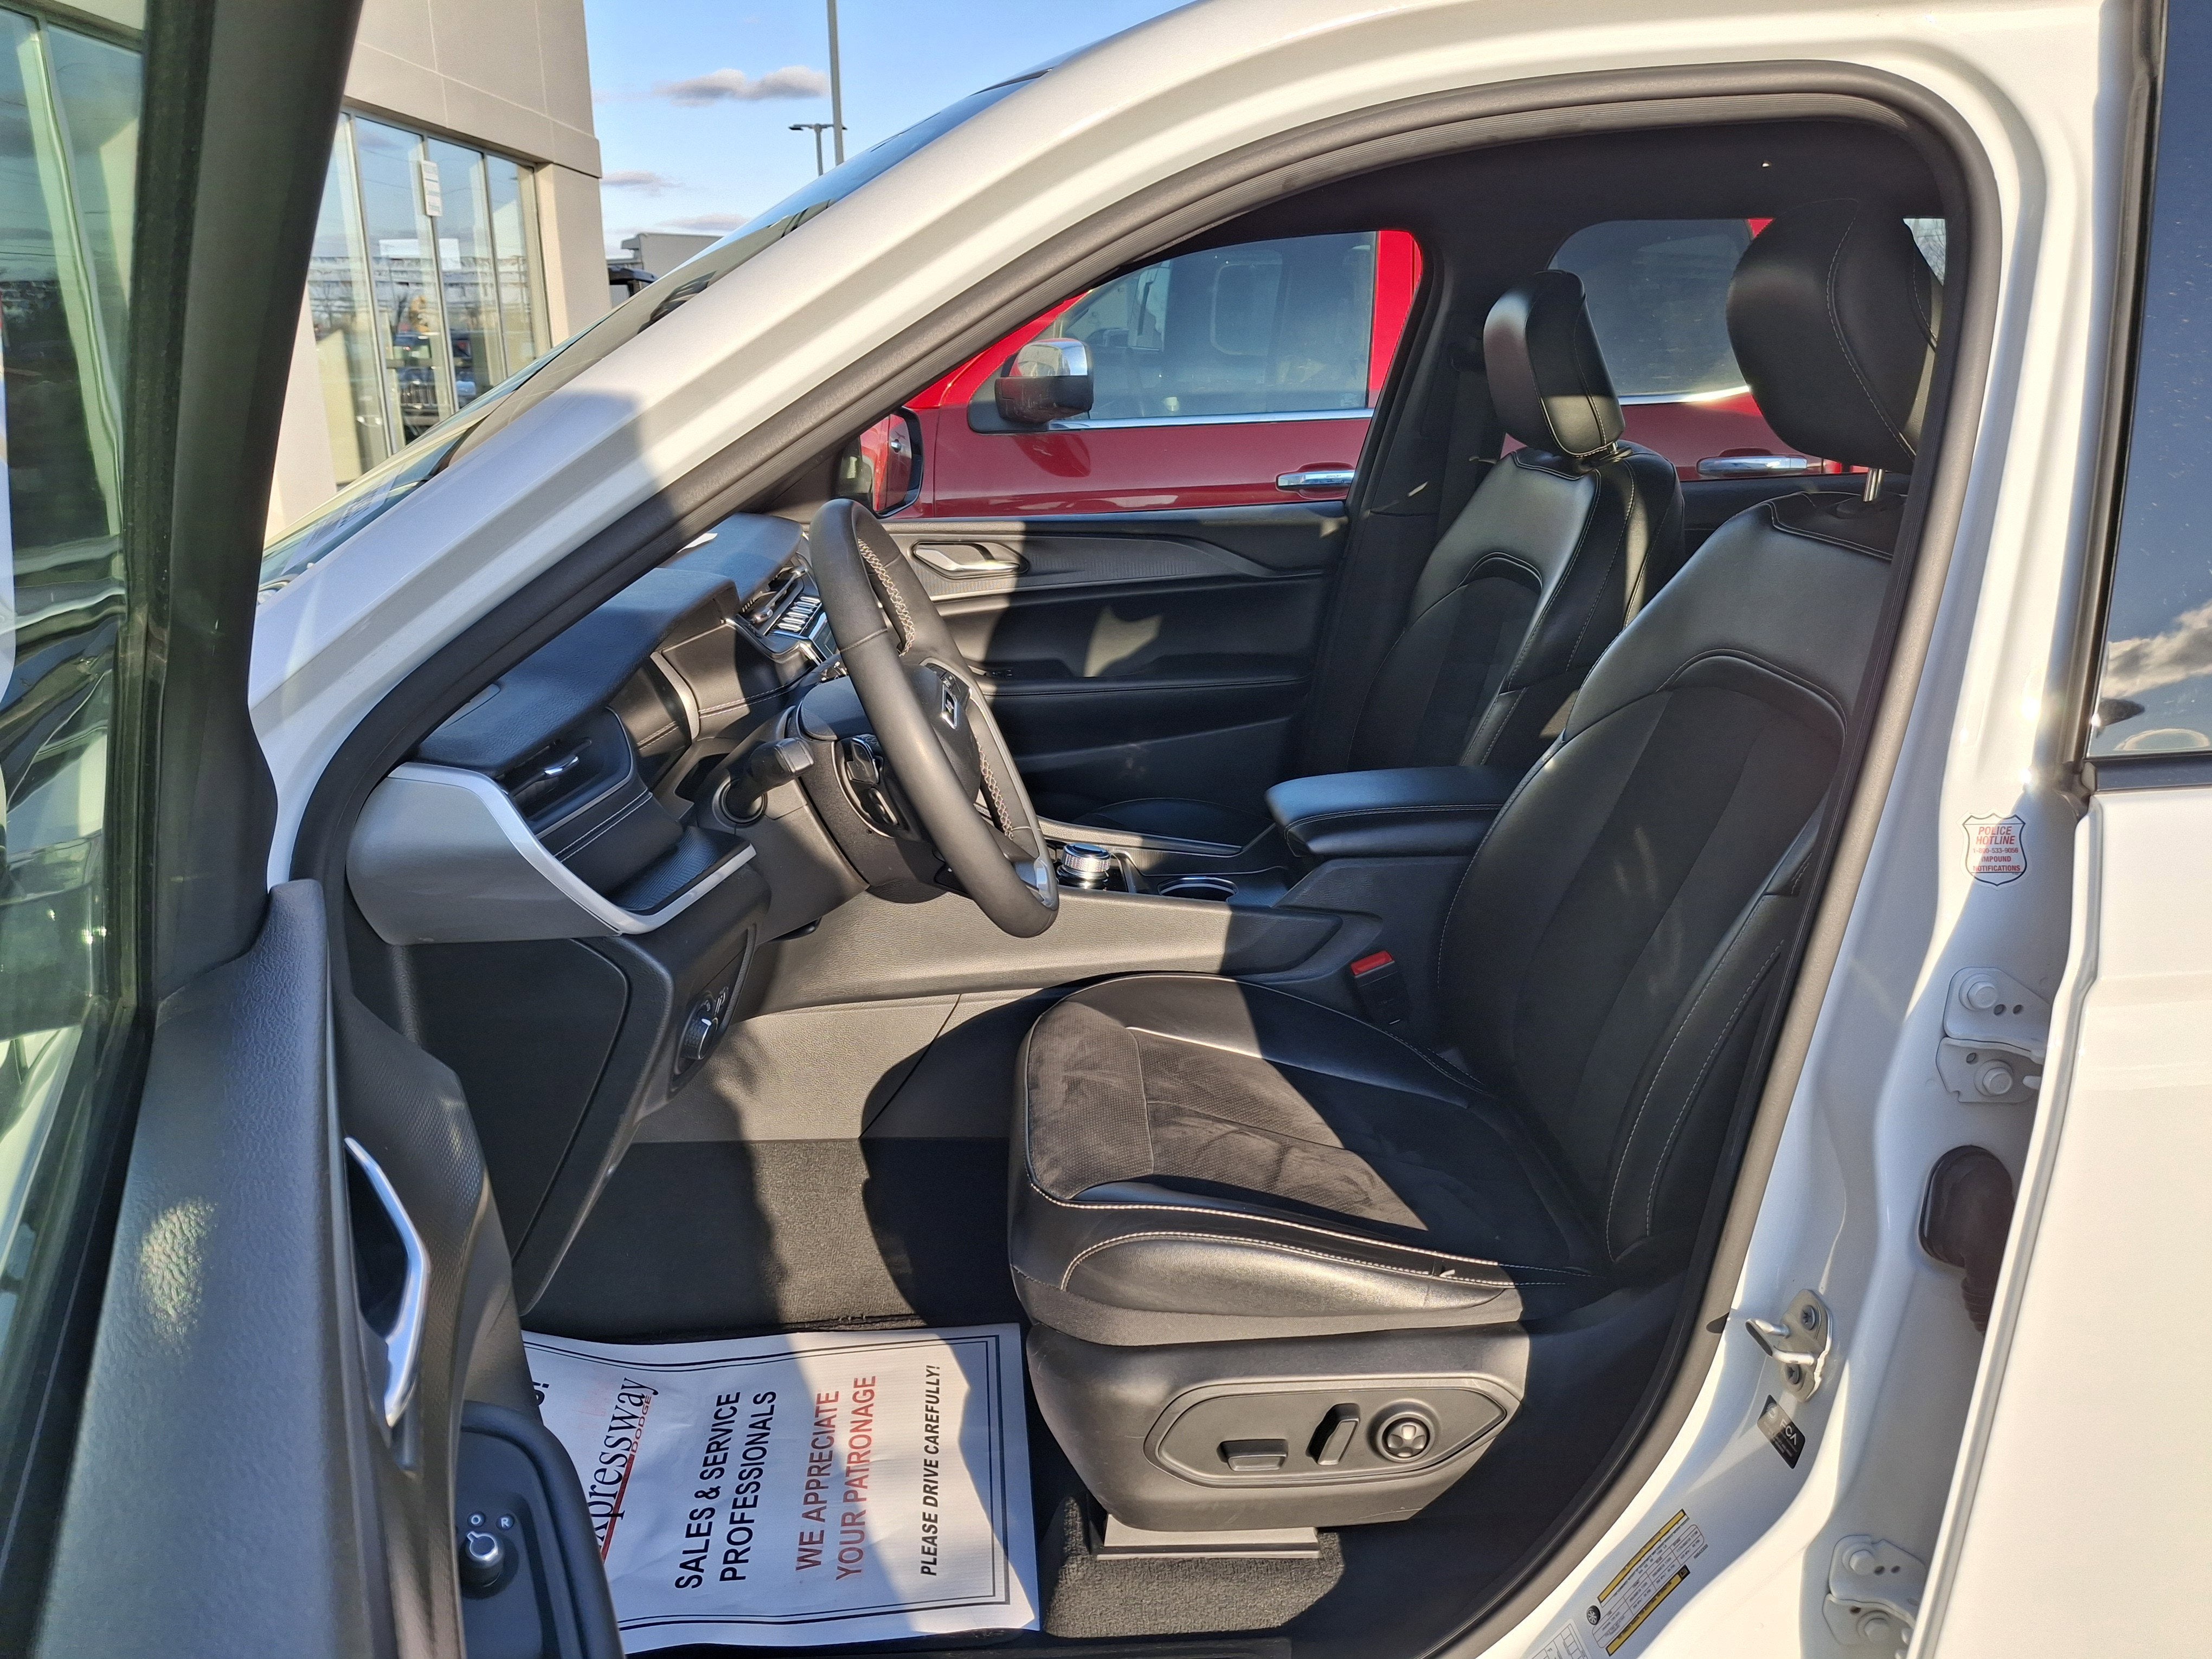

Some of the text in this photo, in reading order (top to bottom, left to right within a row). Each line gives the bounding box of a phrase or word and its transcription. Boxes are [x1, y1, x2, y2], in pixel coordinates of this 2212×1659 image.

[1976, 835, 2015, 845] HOTLINE
[1978, 826, 2012, 835] POLICE
[588, 1377, 659, 1549] xpressway
[631, 1395, 652, 1453] DODGE
[674, 1392, 741, 1589] SALES & SERVICE
[719, 1391, 776, 1581] PROFESSIONALS
[795, 1391, 839, 1571] WE APPRECIATE
[835, 1375, 876, 1580] YOUR PATRONAGE
[920, 1365, 941, 1577] PLEASE DRIVE CAREFULLY!
[1780, 1418, 1797, 1446] FCA
[500, 1517, 510, 1528] R
